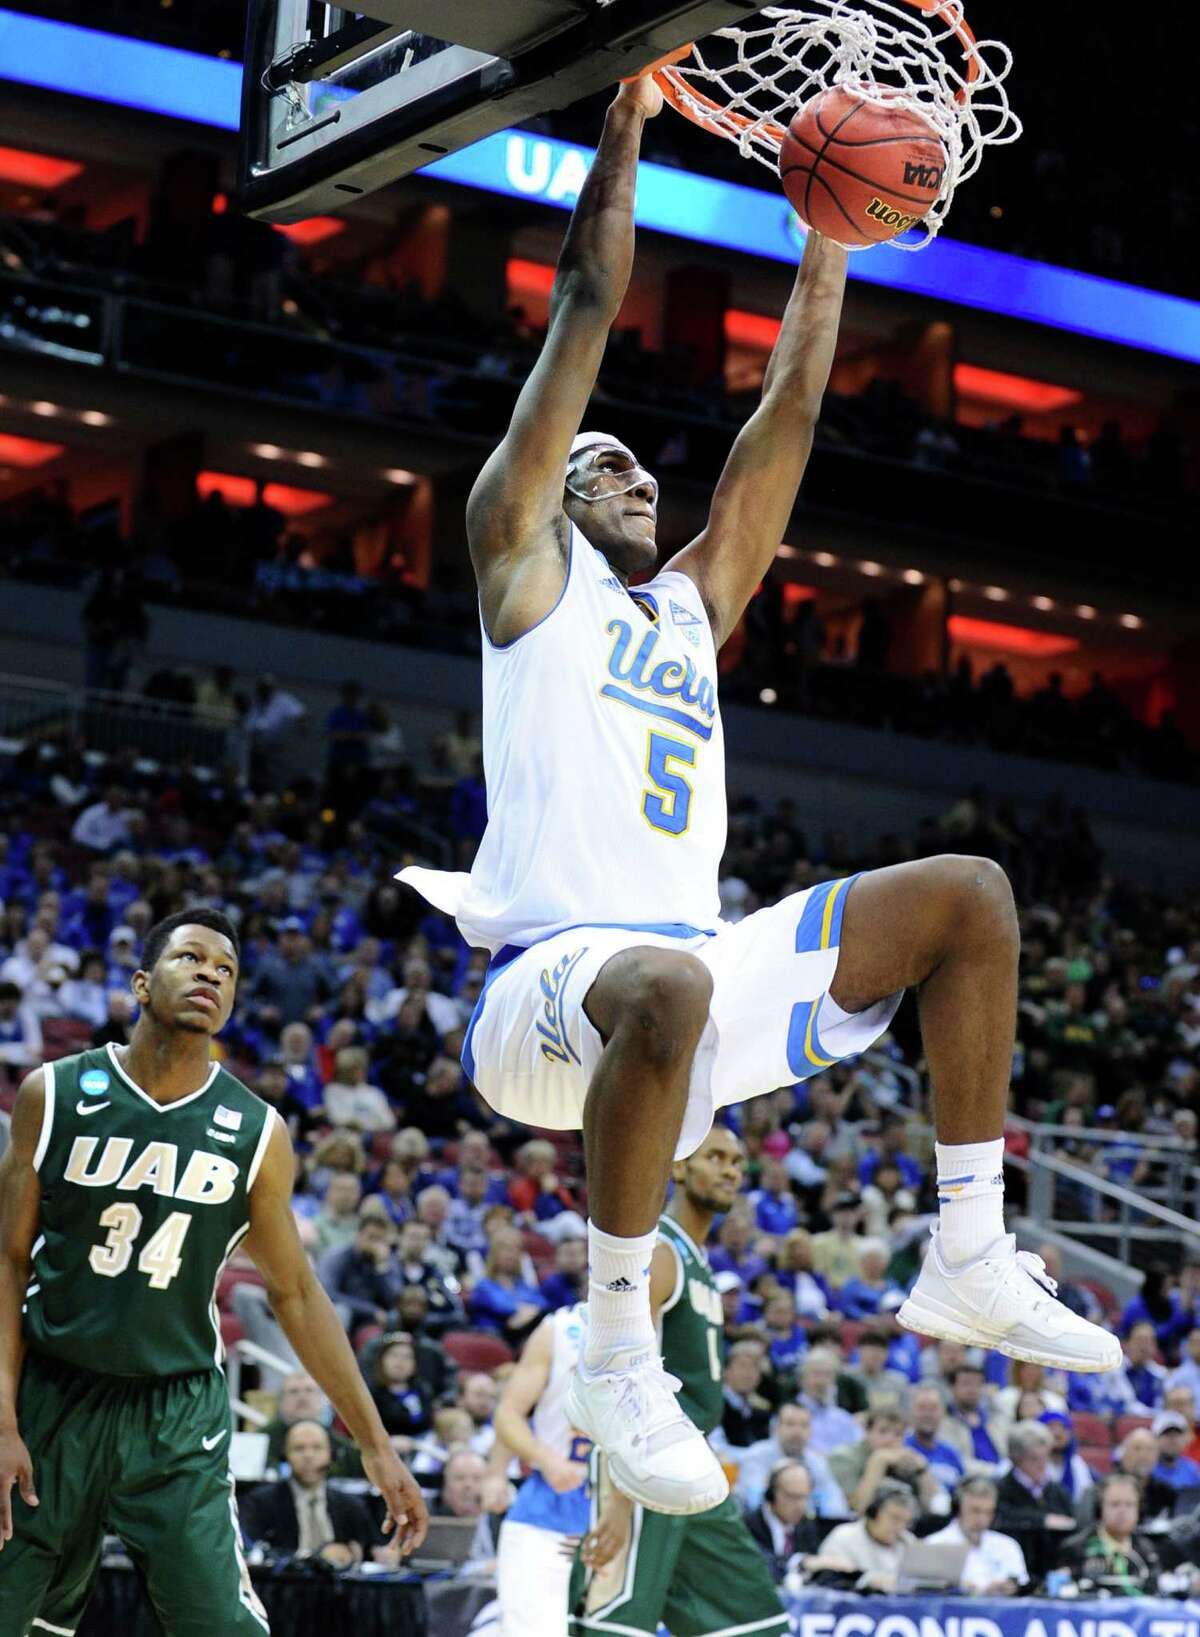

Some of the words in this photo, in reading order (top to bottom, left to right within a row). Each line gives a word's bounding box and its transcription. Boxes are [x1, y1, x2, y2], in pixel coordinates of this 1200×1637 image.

[505, 135, 590, 200] UA
[903, 161, 944, 190] CAA
[640, 729, 697, 839] 5
[64, 1136, 239, 1204] UAB
[89, 1202, 192, 1290] 34
